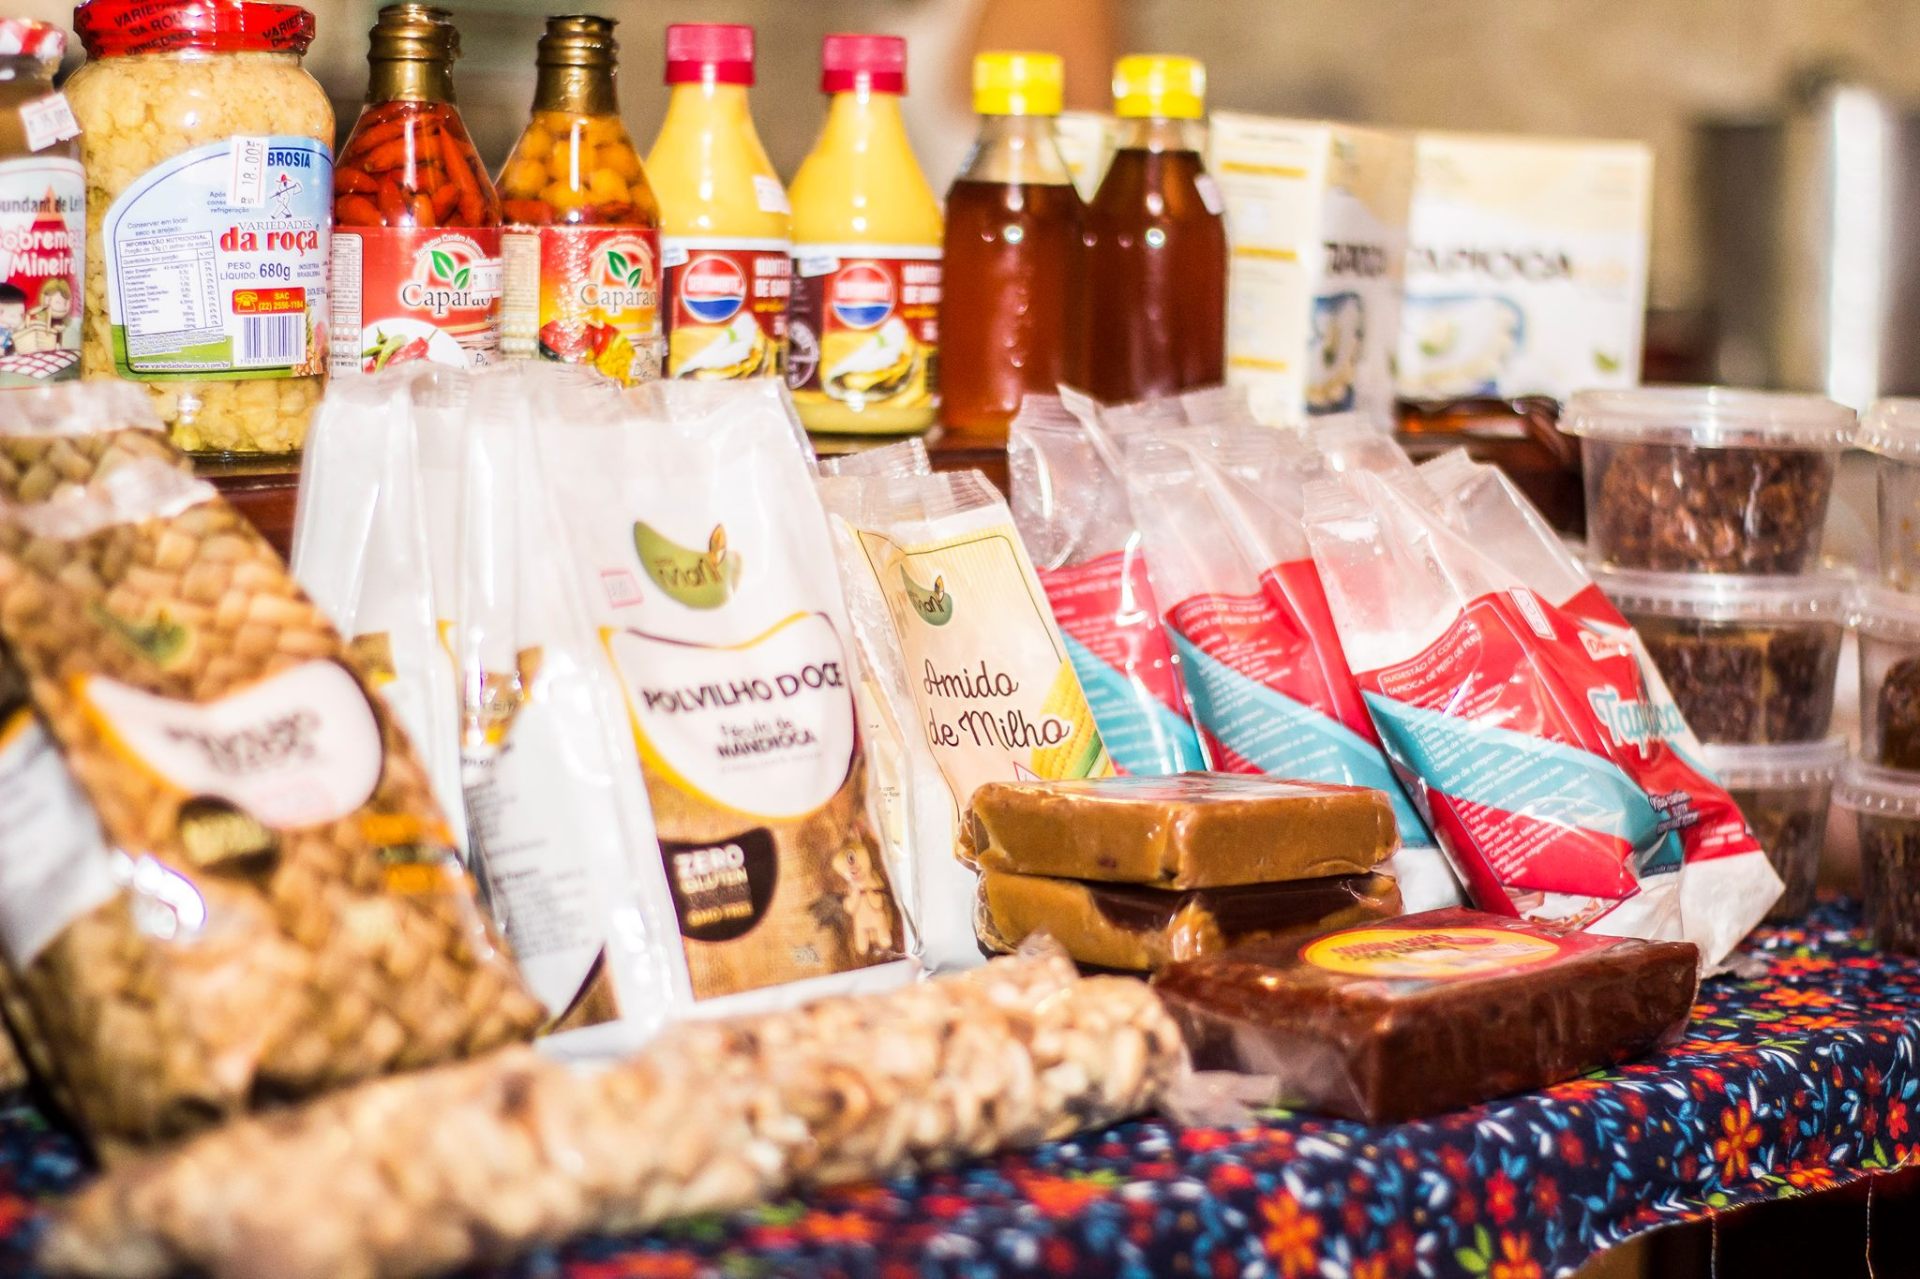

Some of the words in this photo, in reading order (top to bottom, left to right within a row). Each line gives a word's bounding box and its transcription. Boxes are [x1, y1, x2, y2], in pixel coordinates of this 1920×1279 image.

[267, 151, 311, 168] BROSIA
[238, 220, 313, 231] VARIEDADES
[220, 227, 259, 252] da
[267, 230, 319, 257] roça
[227, 262, 252, 270] PESO
[259, 262, 291, 281] 680g
[641, 680, 773, 713] POLVILHO
[776, 662, 844, 697] DOCE
[923, 658, 1019, 698] Amido
[929, 706, 960, 748] de
[958, 709, 1071, 752] Milho
[1588, 687, 1686, 756] Tapioca
[717, 731, 817, 758] MANDIOCA
[673, 843, 746, 880] ZERO
